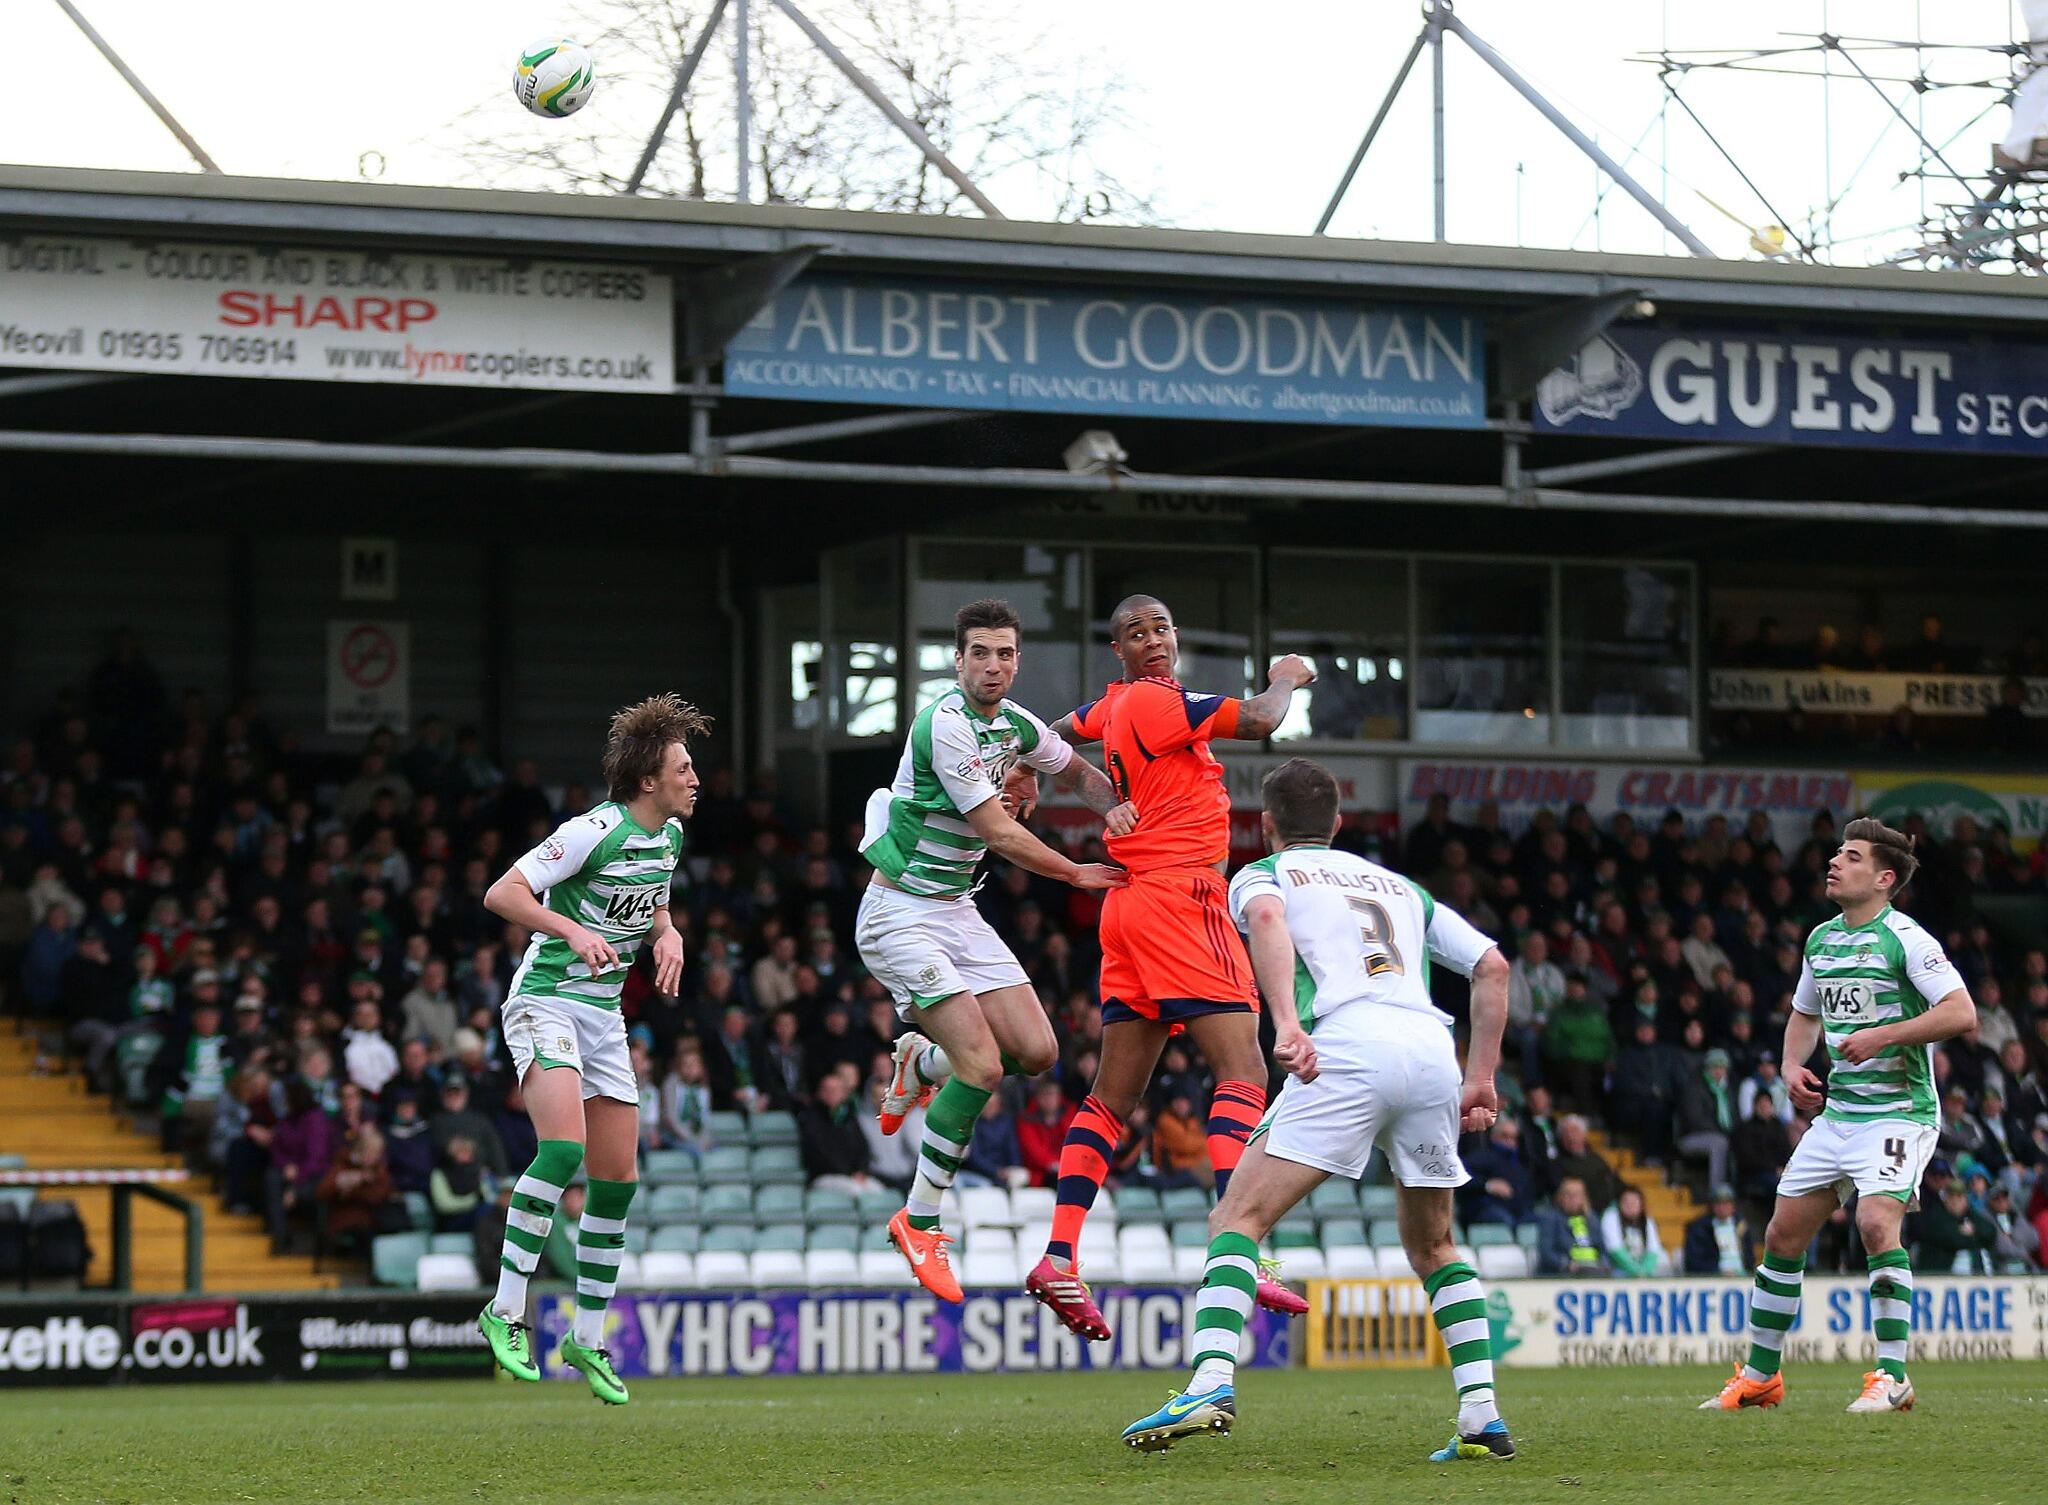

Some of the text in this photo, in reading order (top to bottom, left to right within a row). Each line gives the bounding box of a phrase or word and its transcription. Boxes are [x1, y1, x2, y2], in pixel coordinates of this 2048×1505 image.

[6, 244, 646, 301] DIGITAL COLOUR AND BLACK & WHITE COPIERS
[218, 289, 438, 333] SHARP
[786, 288, 1474, 383] ALBERT GOODMAN
[0, 324, 653, 380] Yeovil 01935 706914 www.lynxcopiers.co.uk
[731, 358, 923, 393] ACCOUNTANCY
[943, 369, 989, 396] TAX
[1009, 373, 1135, 404] FINANCIAL
[1137, 380, 1264, 410] PLANNING
[1648, 337, 1953, 435] GUEST
[1905, 680, 1994, 706] PRESS
[1409, 763, 1854, 812] BUILDING CRAFTSMEN
[1343, 894, 1405, 977] 3
[1884, 1137, 1907, 1168] 4
[635, 1295, 1255, 1376] YHC HIRE SERVIC
[1555, 1287, 1803, 1337] SPARKFO
[1828, 1287, 2013, 1334] STRAGE
[1558, 1340, 1660, 1366] STORAGE
[1938, 1336, 2013, 1363] GOODS
